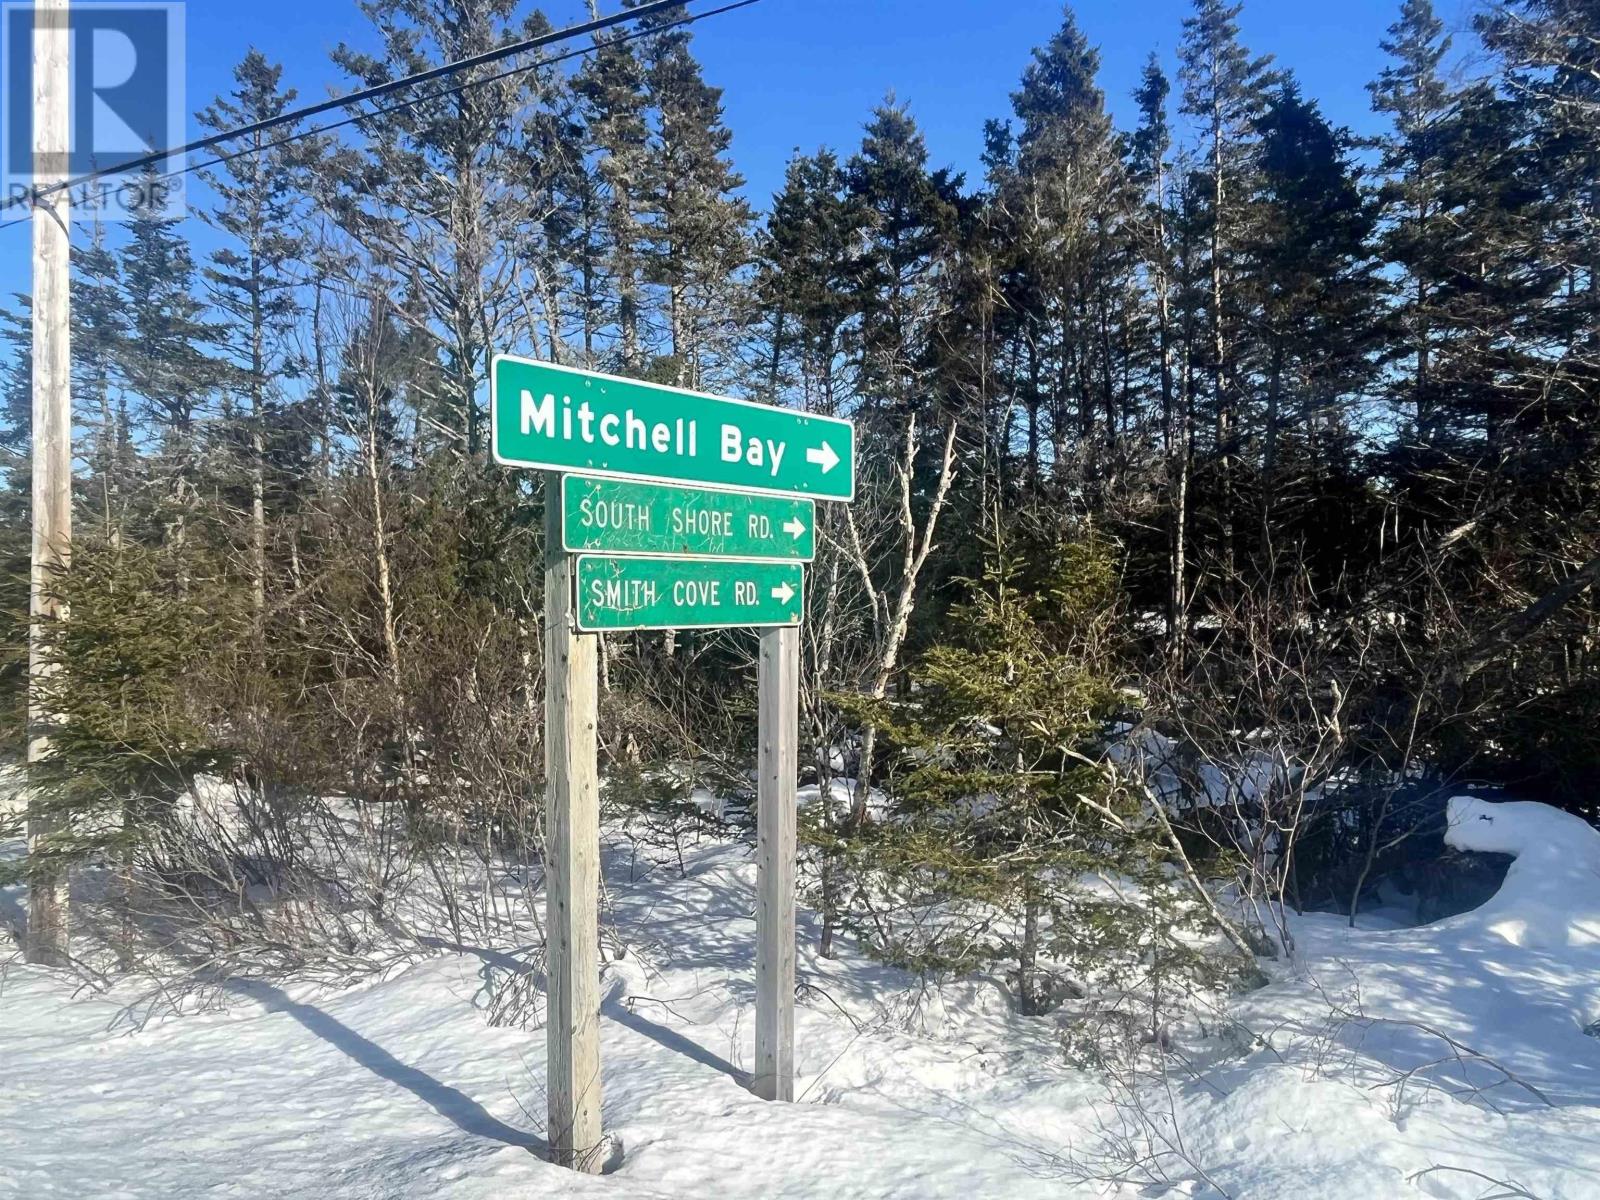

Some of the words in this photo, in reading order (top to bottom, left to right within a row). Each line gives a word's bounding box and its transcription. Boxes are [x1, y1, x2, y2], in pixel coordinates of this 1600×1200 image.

[520, 389, 697, 457] Mitchell
[720, 424, 786, 477] Bay
[580, 499, 650, 531] SOUTH
[672, 508, 733, 537] SHORE
[749, 514, 774, 539] RD.
[591, 579, 656, 607] SMITH
[673, 581, 720, 606] COVE
[735, 581, 760, 606] RD.
